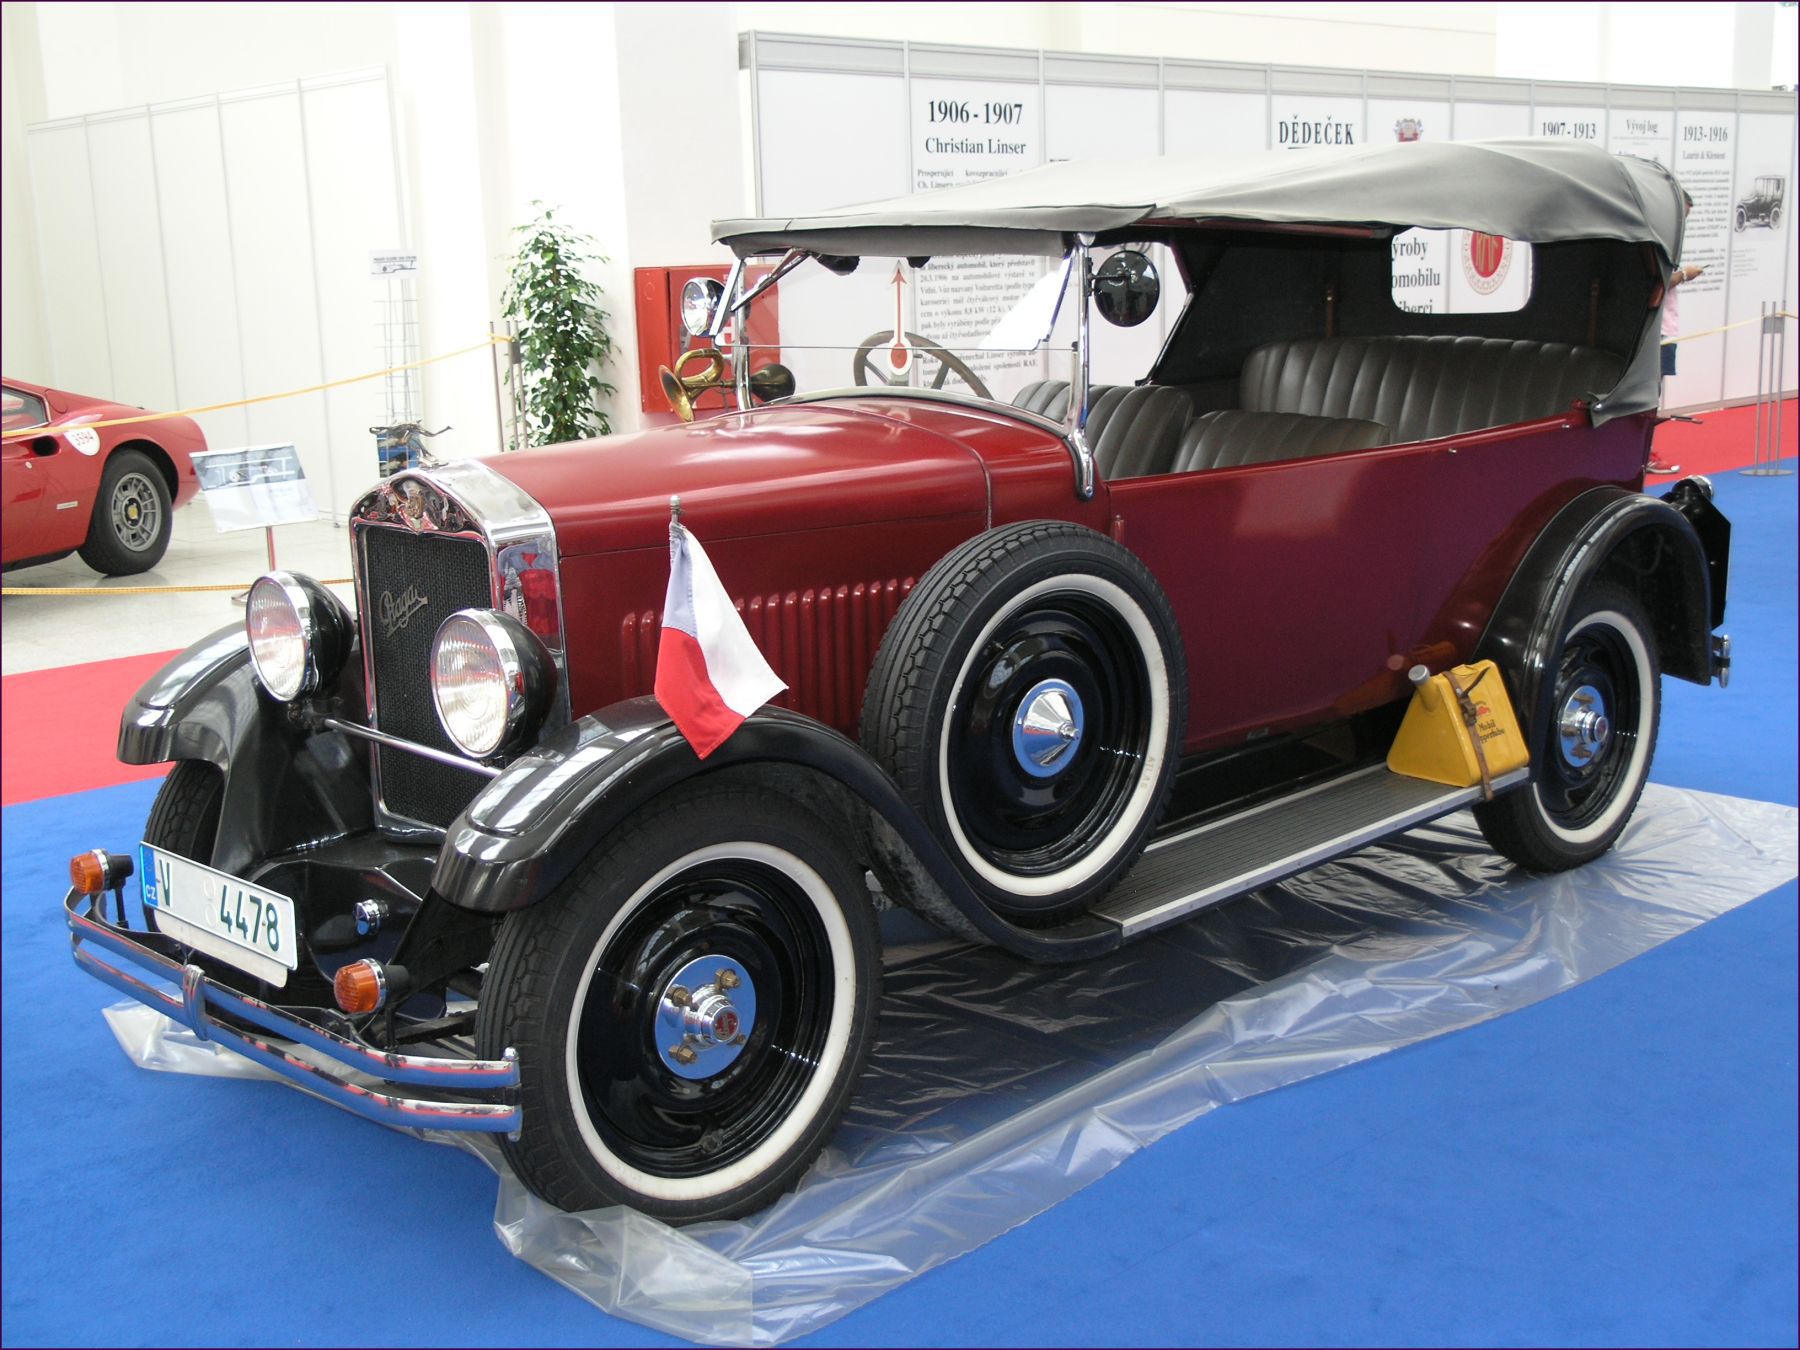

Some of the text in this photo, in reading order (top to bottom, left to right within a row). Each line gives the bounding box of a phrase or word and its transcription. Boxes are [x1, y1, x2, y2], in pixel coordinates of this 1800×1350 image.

[1279, 115, 1354, 145] DĚDEČEK
[925, 137, 1026, 155] Christian Linser
[1392, 236, 1429, 261] ýroby
[1392, 267, 1441, 289] omobilu
[1399, 299, 1434, 314] berci
[379, 585, 429, 638] Praga
[145, 885, 157, 900] CZ
[220, 884, 280, 952] 4478
